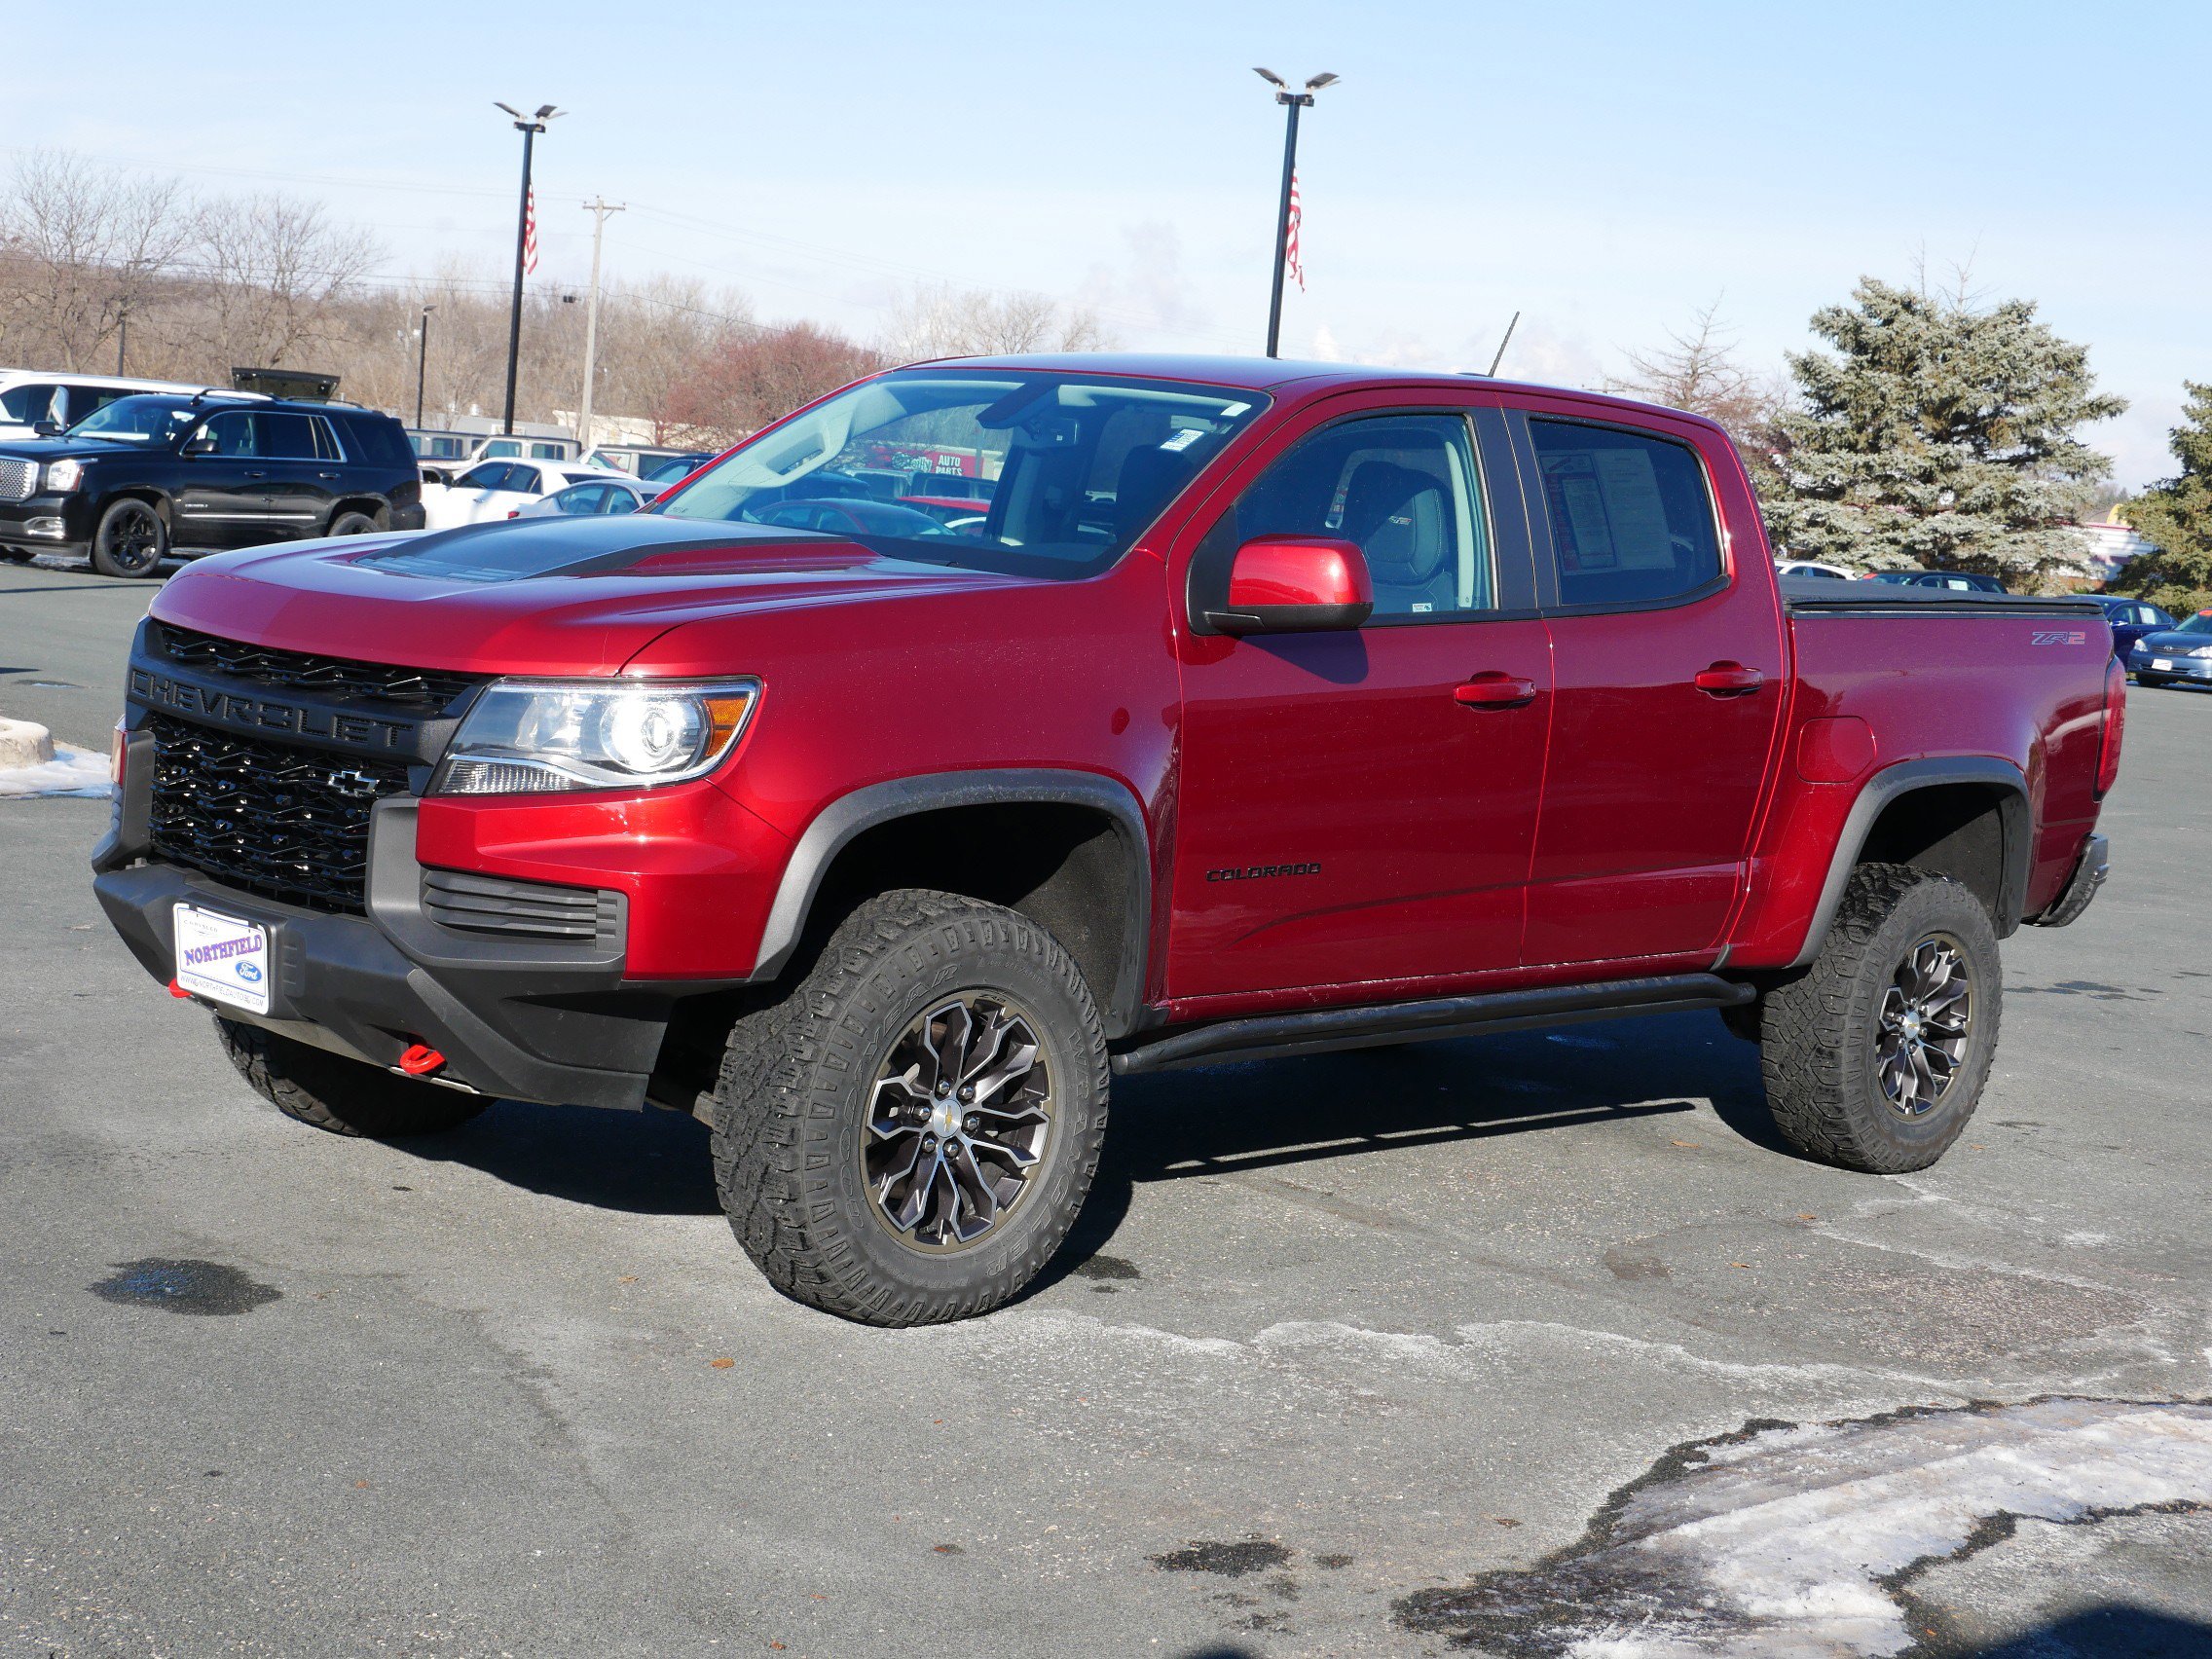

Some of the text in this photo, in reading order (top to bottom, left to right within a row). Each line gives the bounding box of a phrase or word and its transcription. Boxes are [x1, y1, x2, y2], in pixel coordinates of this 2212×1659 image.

[938, 454, 961, 467] AUTO
[935, 465, 963, 477] PARTS
[2031, 631, 2085, 645] ZR2
[131, 668, 415, 748] CHEVROLET
[1205, 862, 1321, 882] COLORADO
[183, 934, 263, 967] NORTHFIELD
[240, 962, 259, 980] Ford
